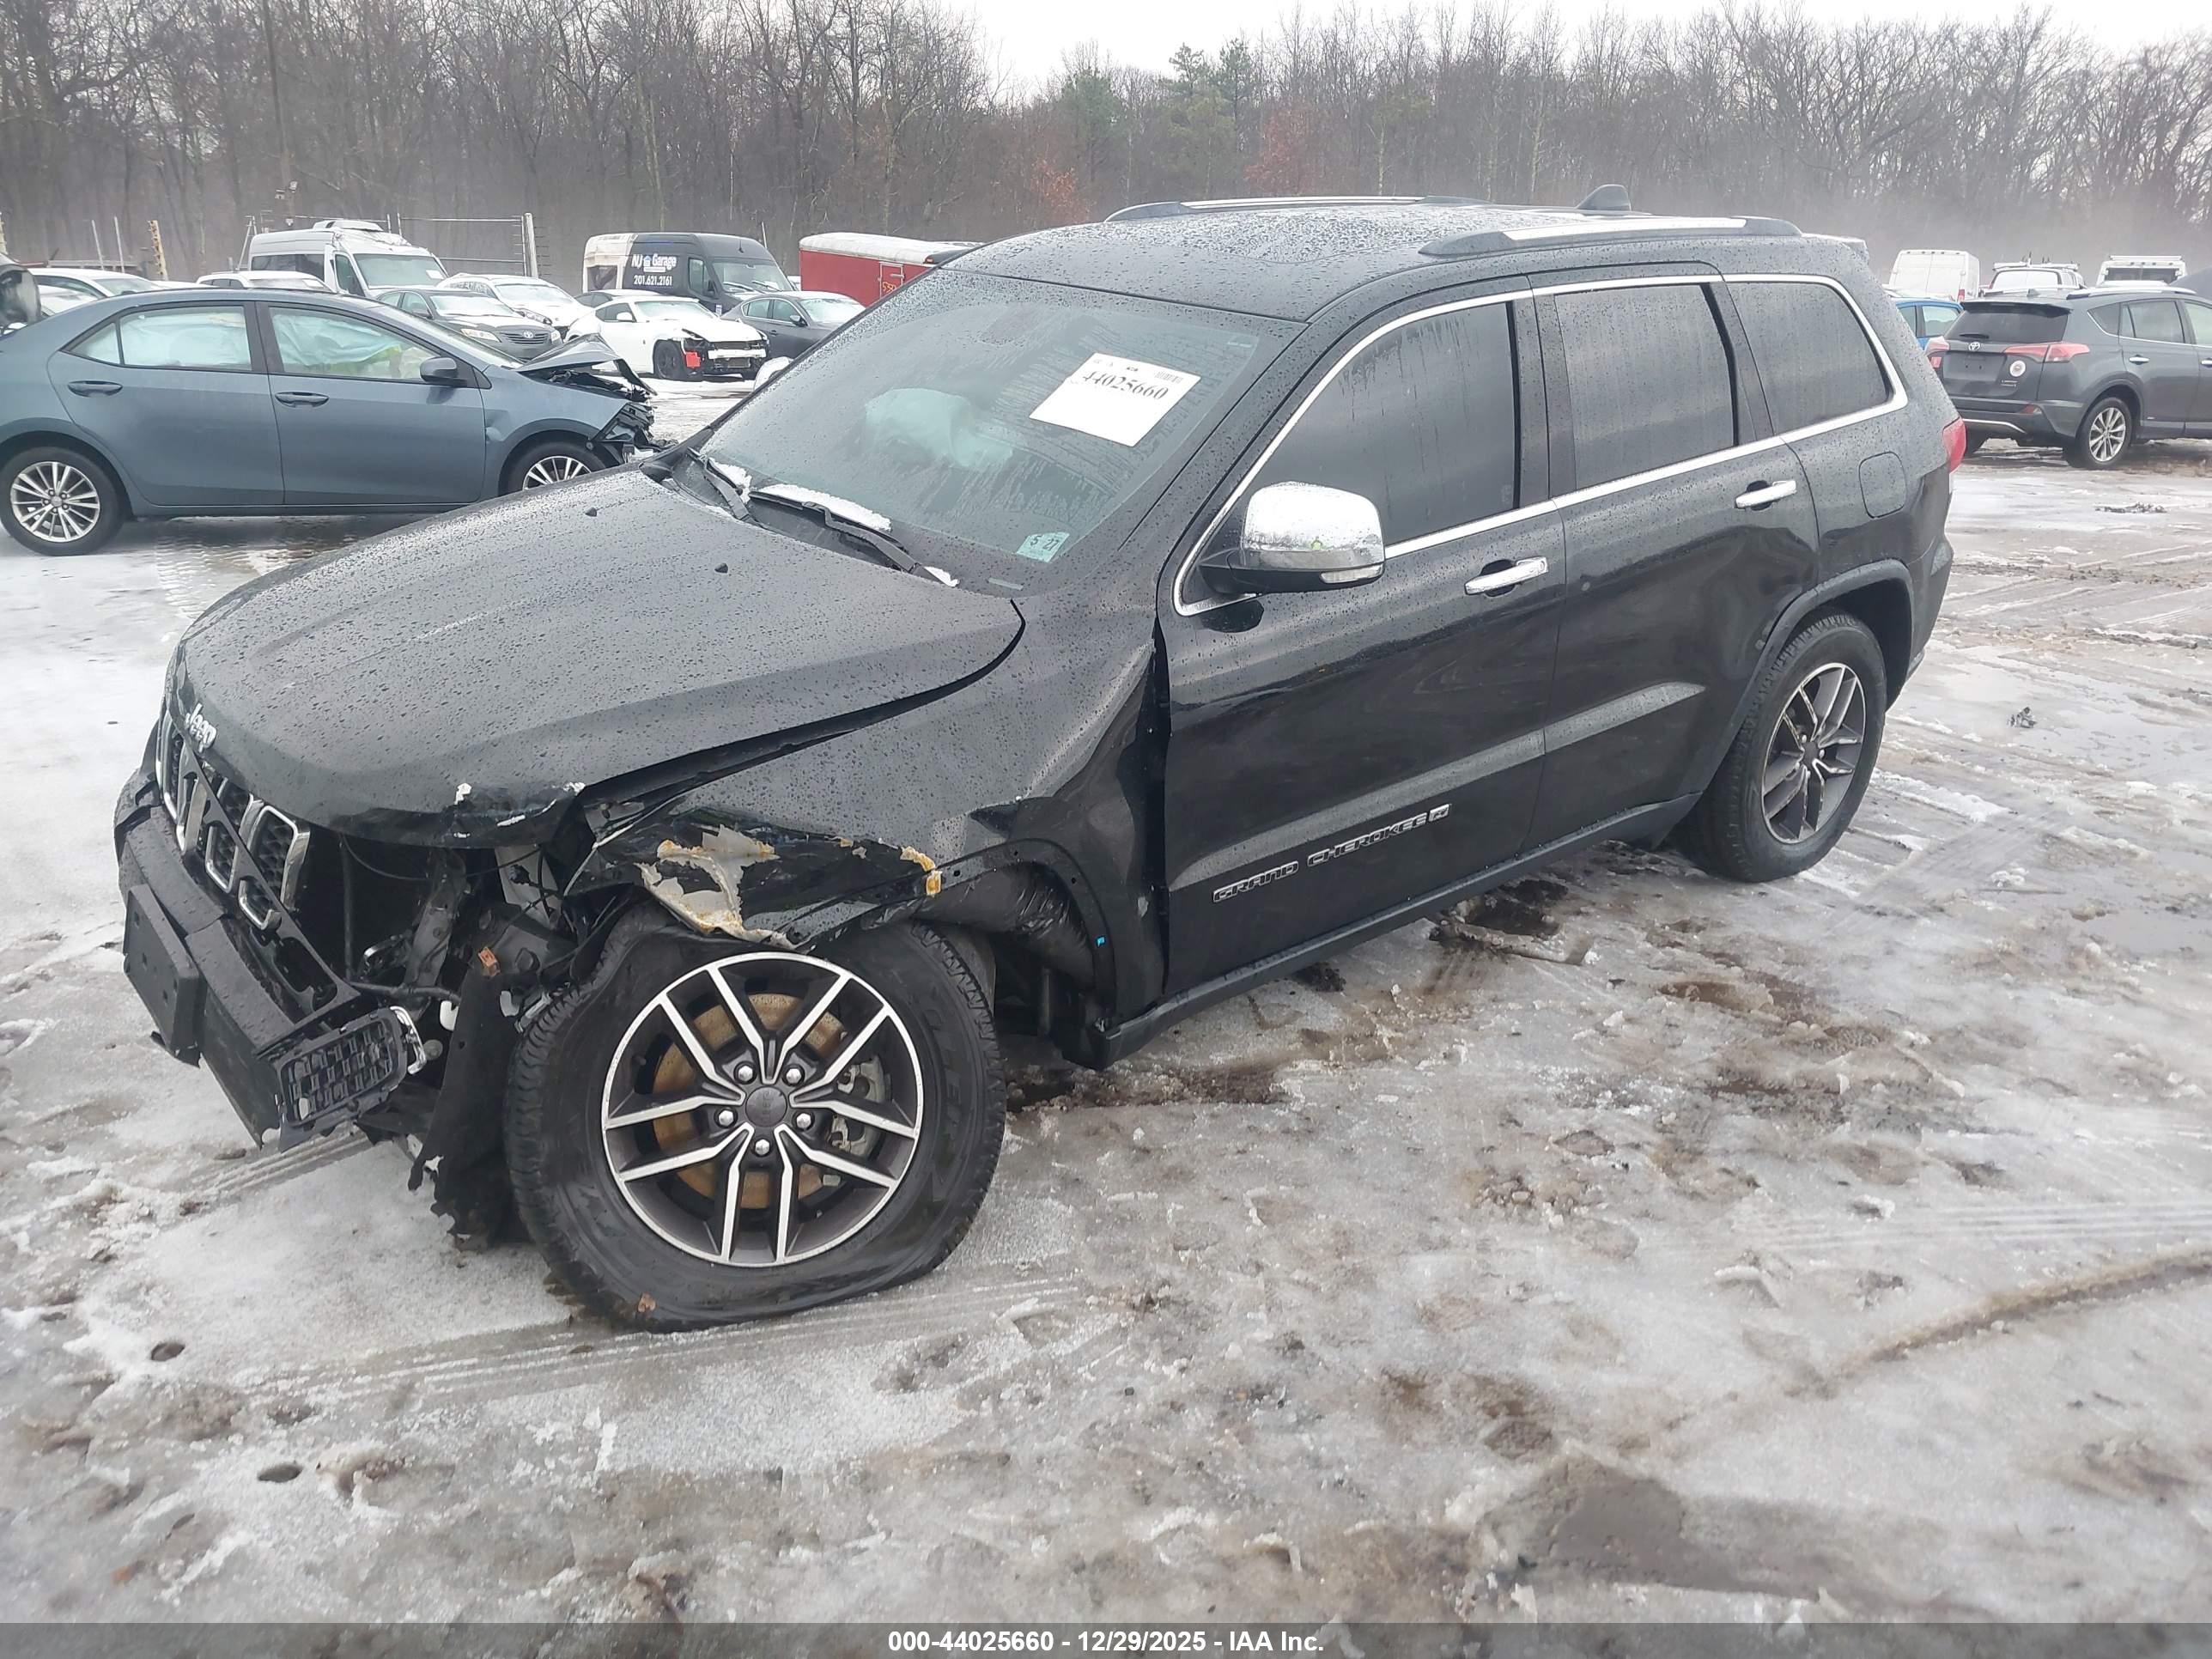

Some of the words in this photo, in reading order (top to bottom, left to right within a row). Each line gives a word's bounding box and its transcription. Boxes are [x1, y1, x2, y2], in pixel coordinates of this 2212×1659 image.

[631, 253, 643, 269] NJ
[652, 253, 677, 270] Garage
[634, 275, 672, 286] 201.621.2161
[1082, 371, 1169, 400] 44025660
[1030, 535, 1042, 546] 5
[1042, 538, 1060, 551] 27
[184, 702, 217, 753] Jeep
[1212, 860, 1299, 902] GRAND
[1307, 812, 1428, 867] CHEROKEE
